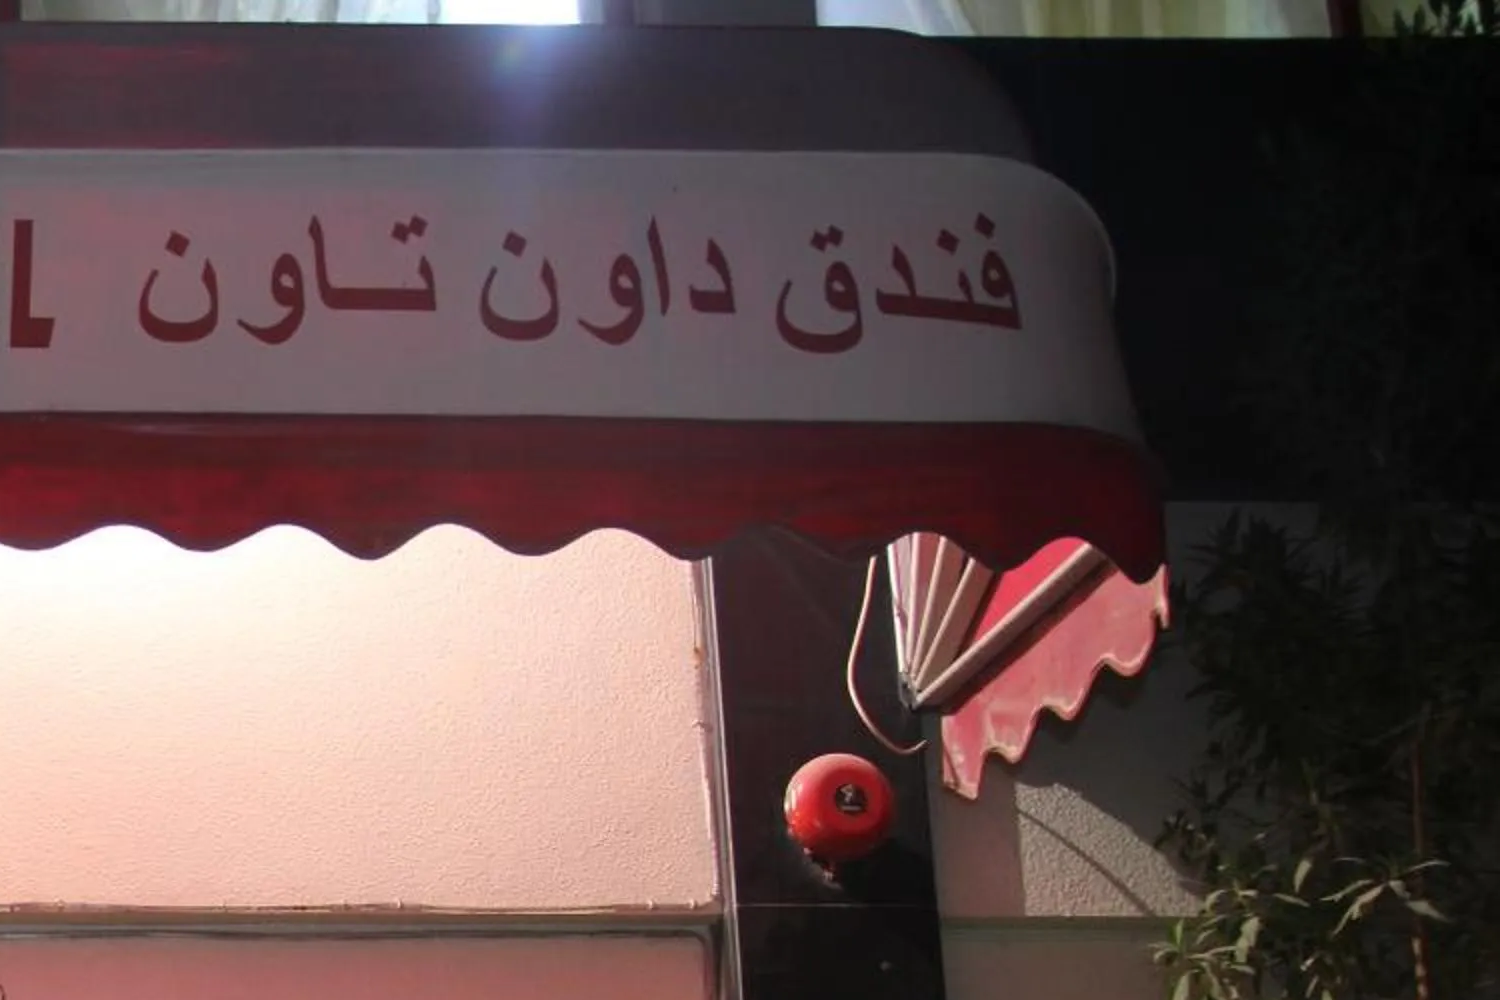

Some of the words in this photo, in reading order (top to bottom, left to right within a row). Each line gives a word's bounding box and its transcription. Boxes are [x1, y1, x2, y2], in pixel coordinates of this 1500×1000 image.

[137, 213, 438, 347] تاون
[478, 213, 737, 347] داون
[774, 211, 1024, 355] فندق
